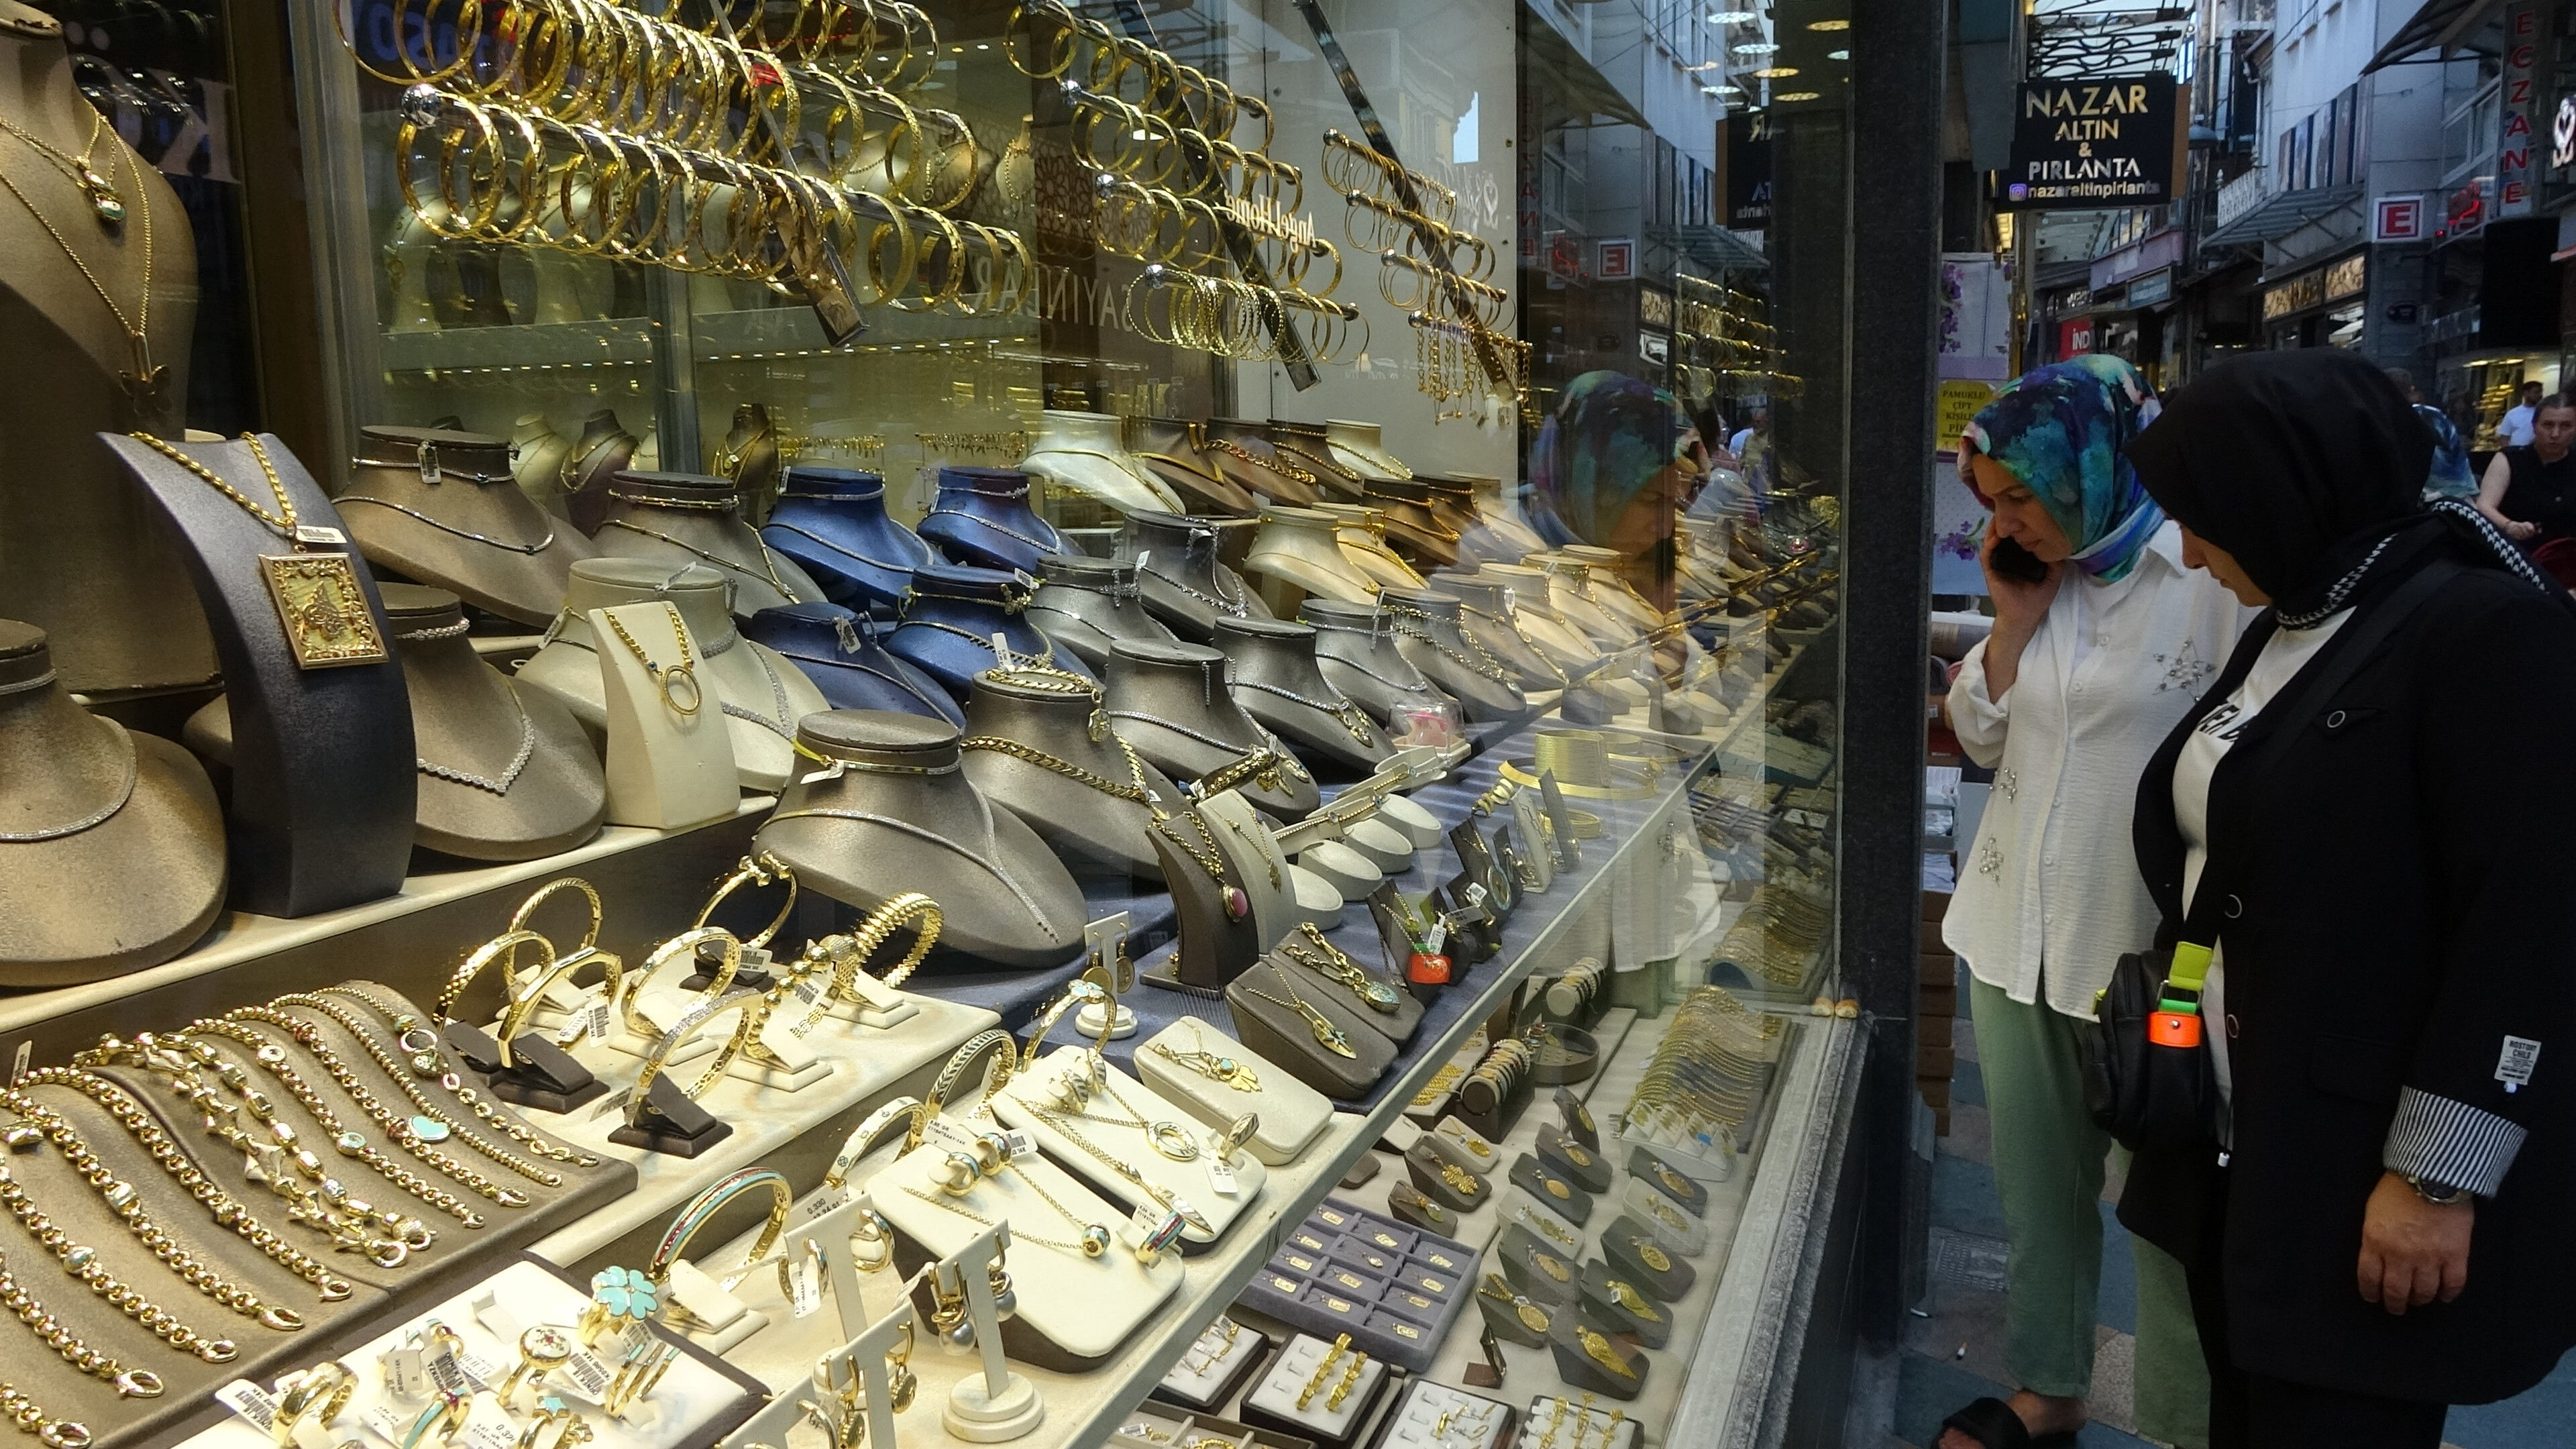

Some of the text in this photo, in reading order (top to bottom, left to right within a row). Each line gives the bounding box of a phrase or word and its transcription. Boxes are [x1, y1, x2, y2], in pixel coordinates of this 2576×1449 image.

[2026, 85, 2148, 118] NAZAR
[2504, 11, 2534, 204] ECZANE
[2055, 119, 2119, 141] ALTIN
[2079, 142, 2092, 157] &
[2029, 158, 2141, 180] PIRLANTA
[2385, 205, 2411, 233] E
[1942, 390, 1986, 399] PAMUKLU
[805, 1197, 827, 1214] 0.330
